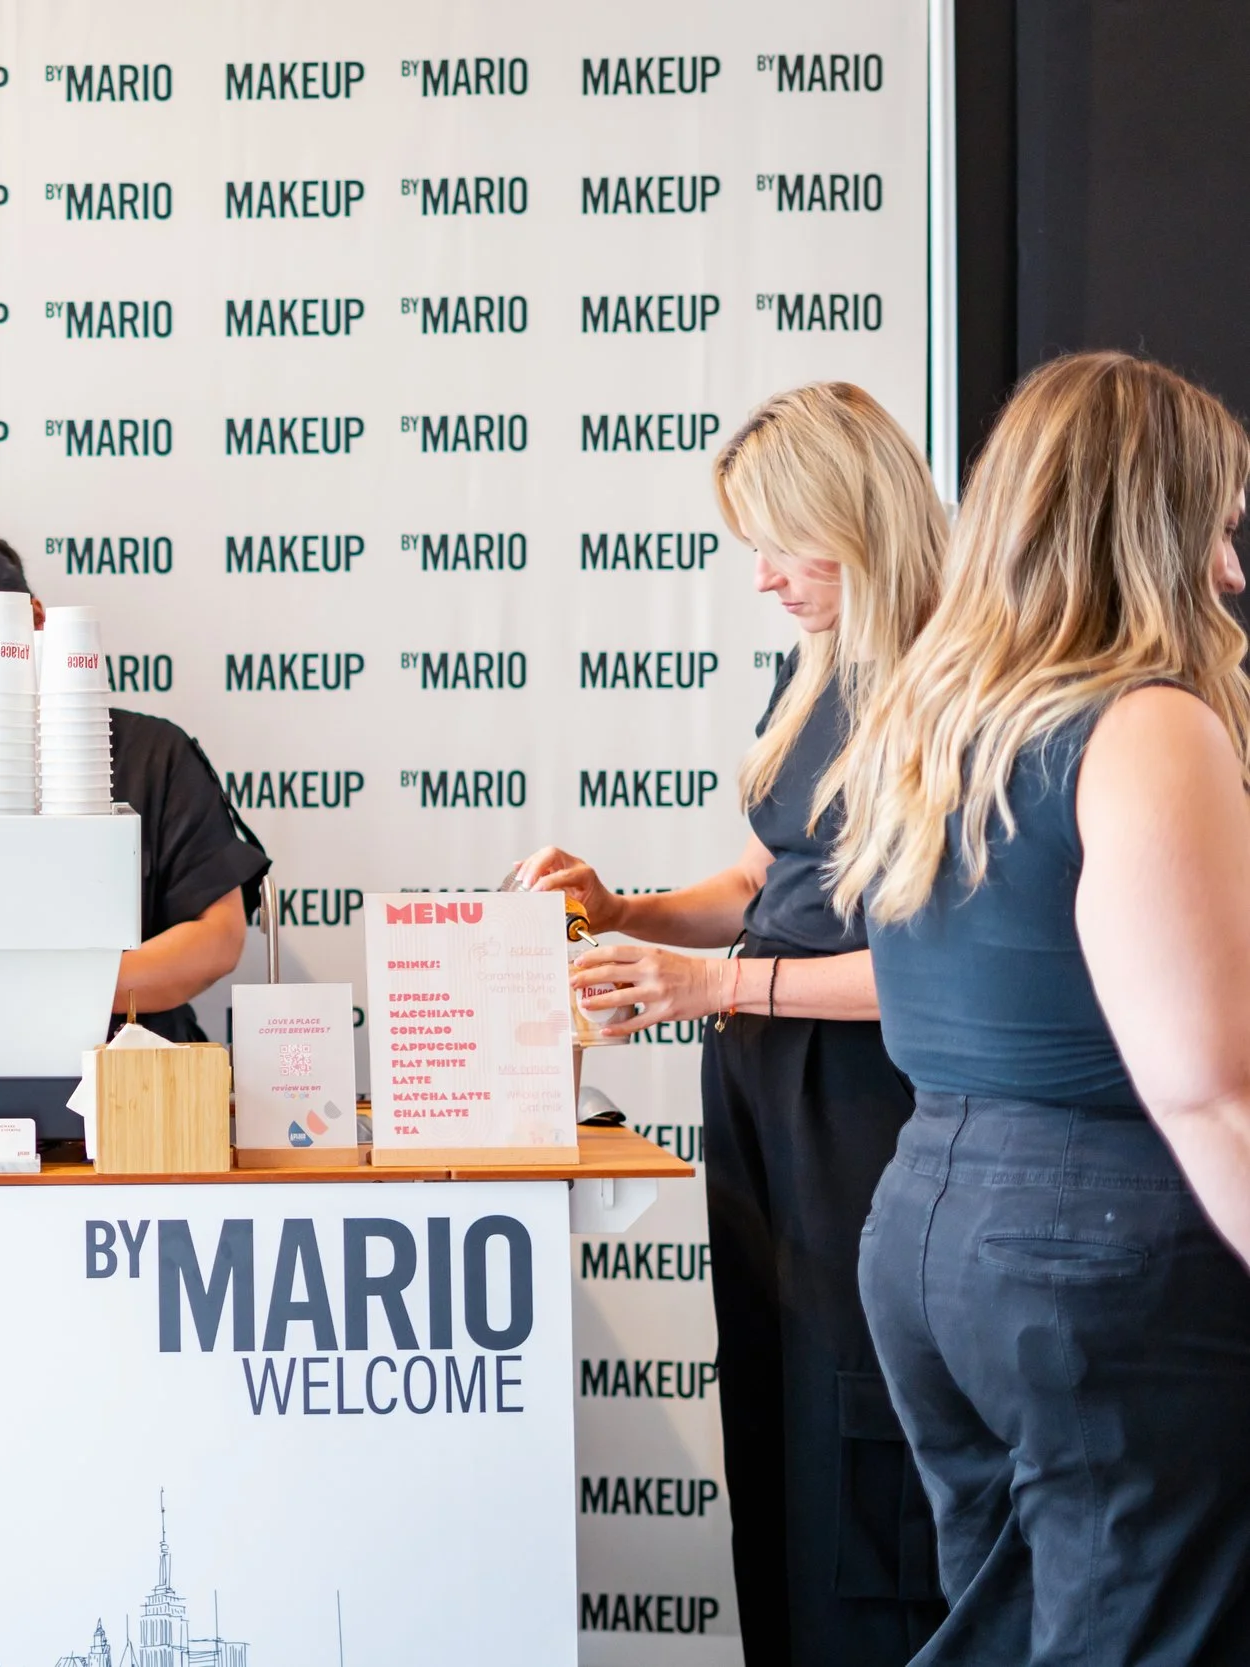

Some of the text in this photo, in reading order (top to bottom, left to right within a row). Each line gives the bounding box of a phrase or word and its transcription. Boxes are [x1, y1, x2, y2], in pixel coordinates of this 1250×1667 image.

[45, 65, 65, 82] BY
[66, 63, 172, 102] MARIO
[226, 57, 528, 101] MAKEUP BY MARIO
[582, 53, 883, 96] MAKEUP BY MARIO
[45, 183, 65, 200] BY
[66, 182, 172, 221] MARIO
[226, 176, 528, 219] MAKEUP BY MARIO
[582, 173, 883, 215] MAKEUP BY MARIO
[45, 301, 65, 318] BY
[66, 300, 173, 339] MARIO
[226, 295, 528, 337] MAKEUP BY MARIO
[581, 293, 883, 334] MAKEUP BY MARIO
[45, 419, 65, 436] BY
[66, 418, 172, 457] MARIO
[226, 414, 528, 456] MAKEUP BY MARIO
[582, 413, 720, 452] MAKEUP
[45, 536, 173, 575] BY MARIO
[226, 532, 527, 574] MAKEUP BY MARIO
[581, 532, 719, 571] MAKEUP
[225, 651, 527, 692] MAKEUP BY MARIO
[580, 651, 719, 689] MAKEUP
[753, 651, 773, 668] BY
[225, 769, 527, 809] MAKEUP BY MARIO
[580, 770, 719, 808] MAKEUP
[279, 888, 364, 927] KEUP
[386, 902, 483, 925] MENU
[387, 960, 440, 969] DRINKS:
[389, 993, 450, 1002] ESPRESSO
[390, 1009, 474, 1018] MACCHIATTO
[390, 1026, 452, 1035] CORTADO
[391, 1042, 477, 1051] CAPPUCCINO
[392, 1058, 466, 1068] FLAT WHITE
[392, 1076, 432, 1085] LATTE
[272, 1084, 299, 1092] review
[393, 1092, 491, 1101] MATCHA LATTE
[394, 1109, 469, 1118] CHAI LATTE
[394, 1126, 420, 1135] TEA
[85, 1219, 151, 1279] BY
[157, 1214, 534, 1353] MARIO
[241, 1354, 525, 1416] WELCOME
[581, 1358, 718, 1400] MAKEUP
[580, 1475, 719, 1518] MAKEUP
[580, 1592, 720, 1635] MAKEUP
